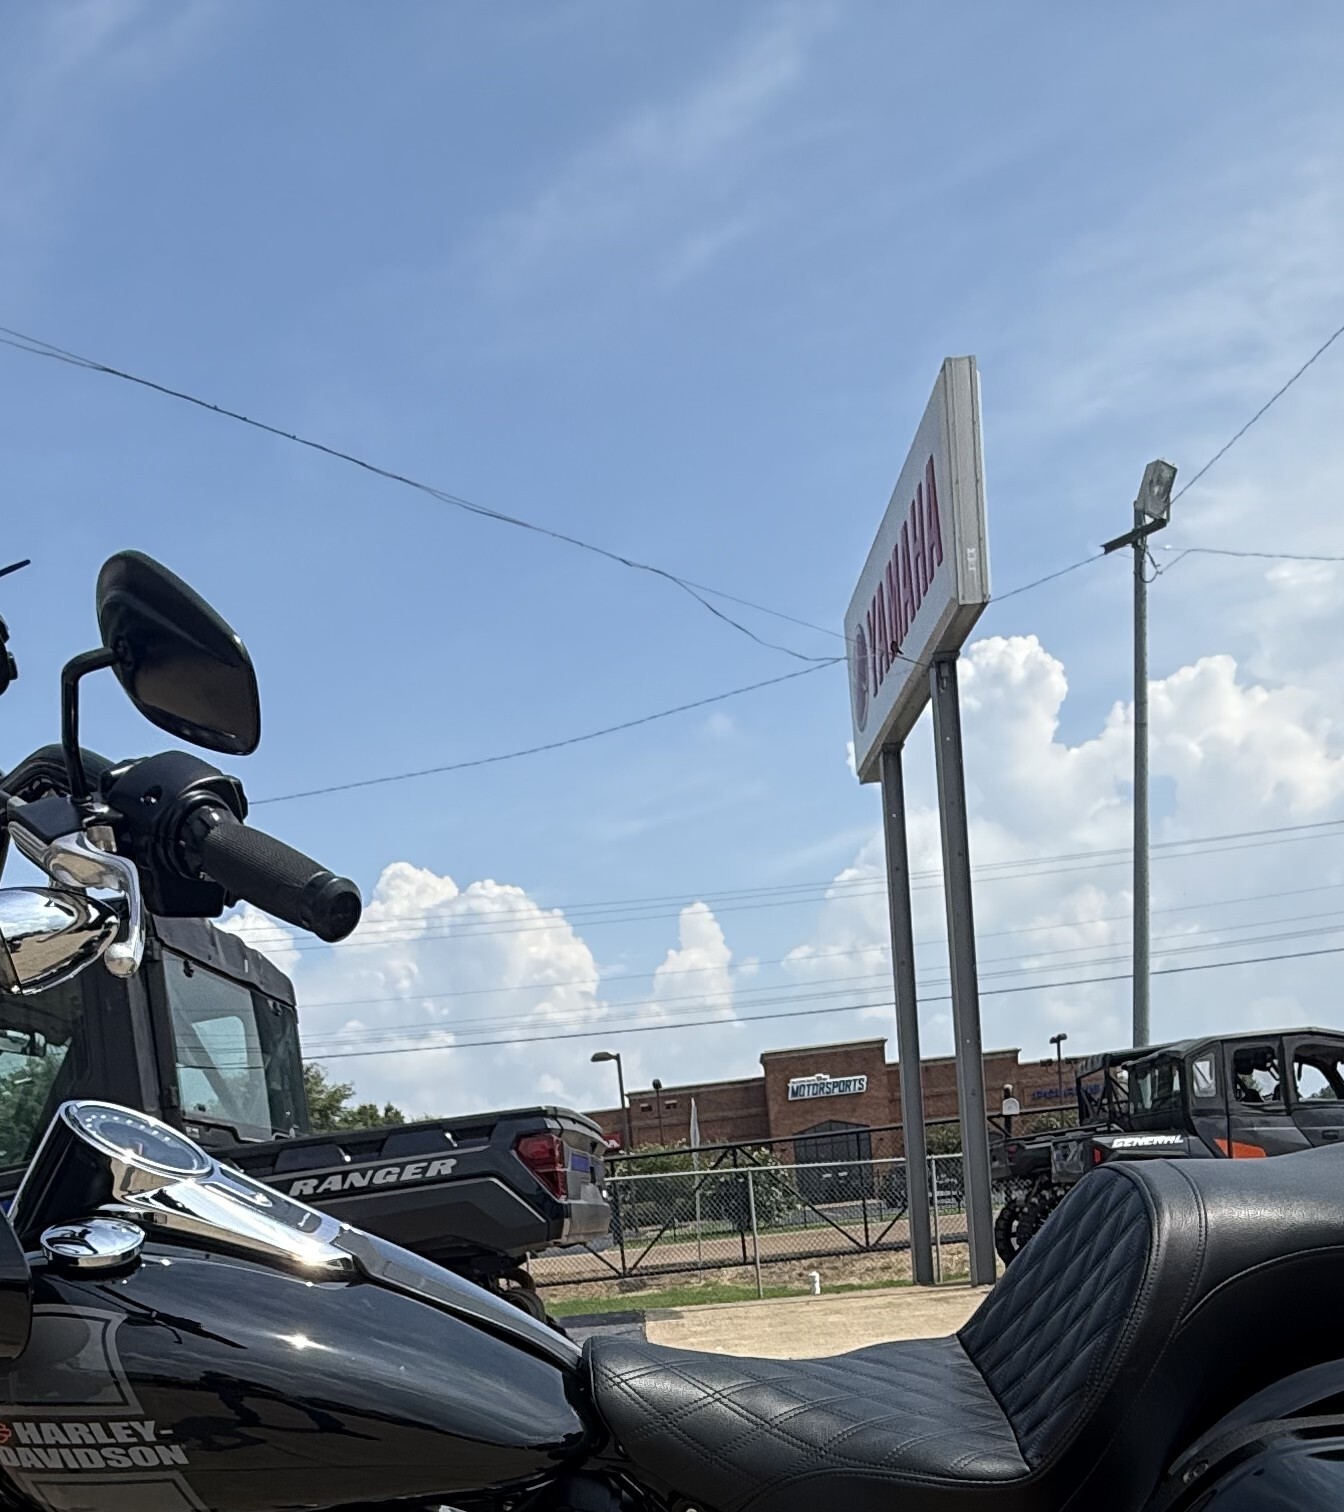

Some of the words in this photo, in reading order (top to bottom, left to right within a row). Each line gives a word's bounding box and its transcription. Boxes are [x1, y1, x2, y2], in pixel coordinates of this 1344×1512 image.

[866, 454, 943, 697] YAMAHA
[791, 1078, 865, 1098] MOTORSPORTS
[1111, 1134, 1184, 1148] GENERAL
[289, 1158, 457, 1197] RANGER
[12, 1420, 174, 1444] HARLEY-
